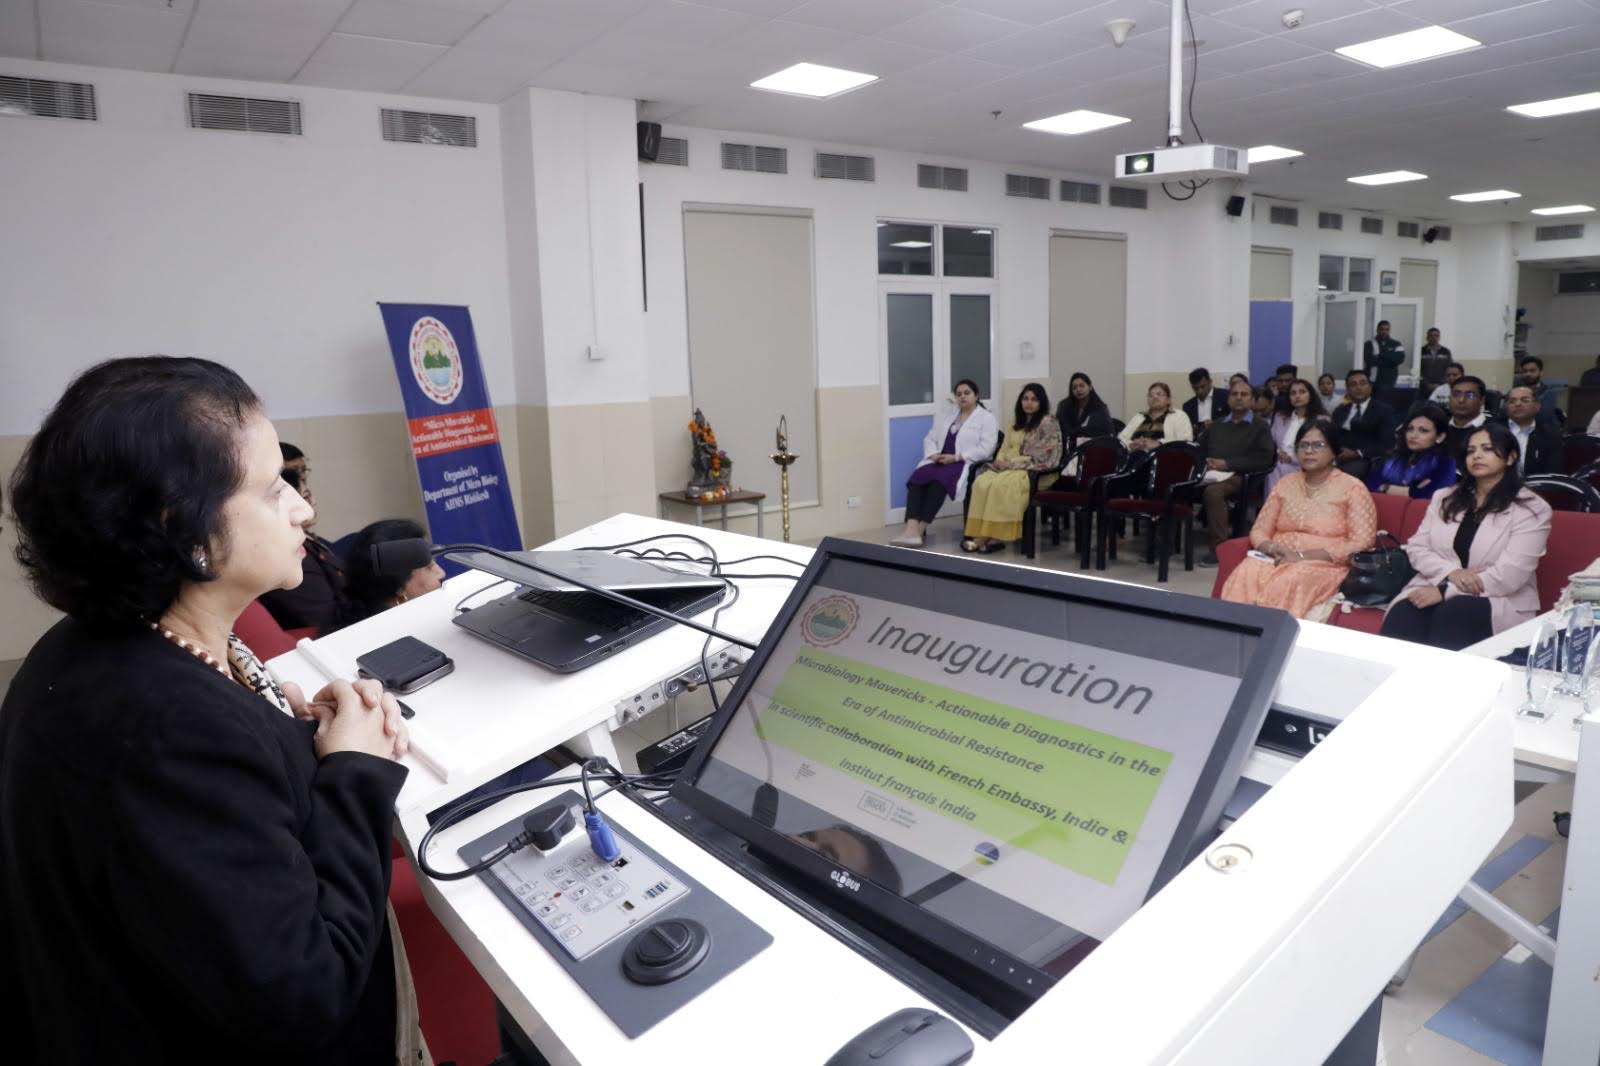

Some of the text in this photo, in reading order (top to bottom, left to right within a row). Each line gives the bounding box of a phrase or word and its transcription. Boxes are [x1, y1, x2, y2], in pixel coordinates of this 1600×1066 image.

[867, 617, 1153, 715] Inauguration
[795, 655, 864, 685] Microbiology
[864, 676, 926, 704] Mavericks
[935, 699, 1011, 730] Actionable
[1012, 722, 1106, 760] Diagnostics
[1107, 751, 1125, 766] in
[1130, 758, 1161, 777] the
[842, 697, 1045, 774] Era of Antimicrobial Resistance
[779, 705, 826, 729] scientific
[825, 725, 904, 760] collaboration
[905, 754, 936, 772] with
[936, 764, 991, 791] French
[986, 783, 1057, 821] Embassy,
[1062, 811, 1109, 838] India
[1111, 829, 1129, 845] &
[839, 758, 884, 783] Institut
[880, 775, 938, 806] français
[938, 799, 977, 822] India
[830, 870, 861, 892] GLOBUS
